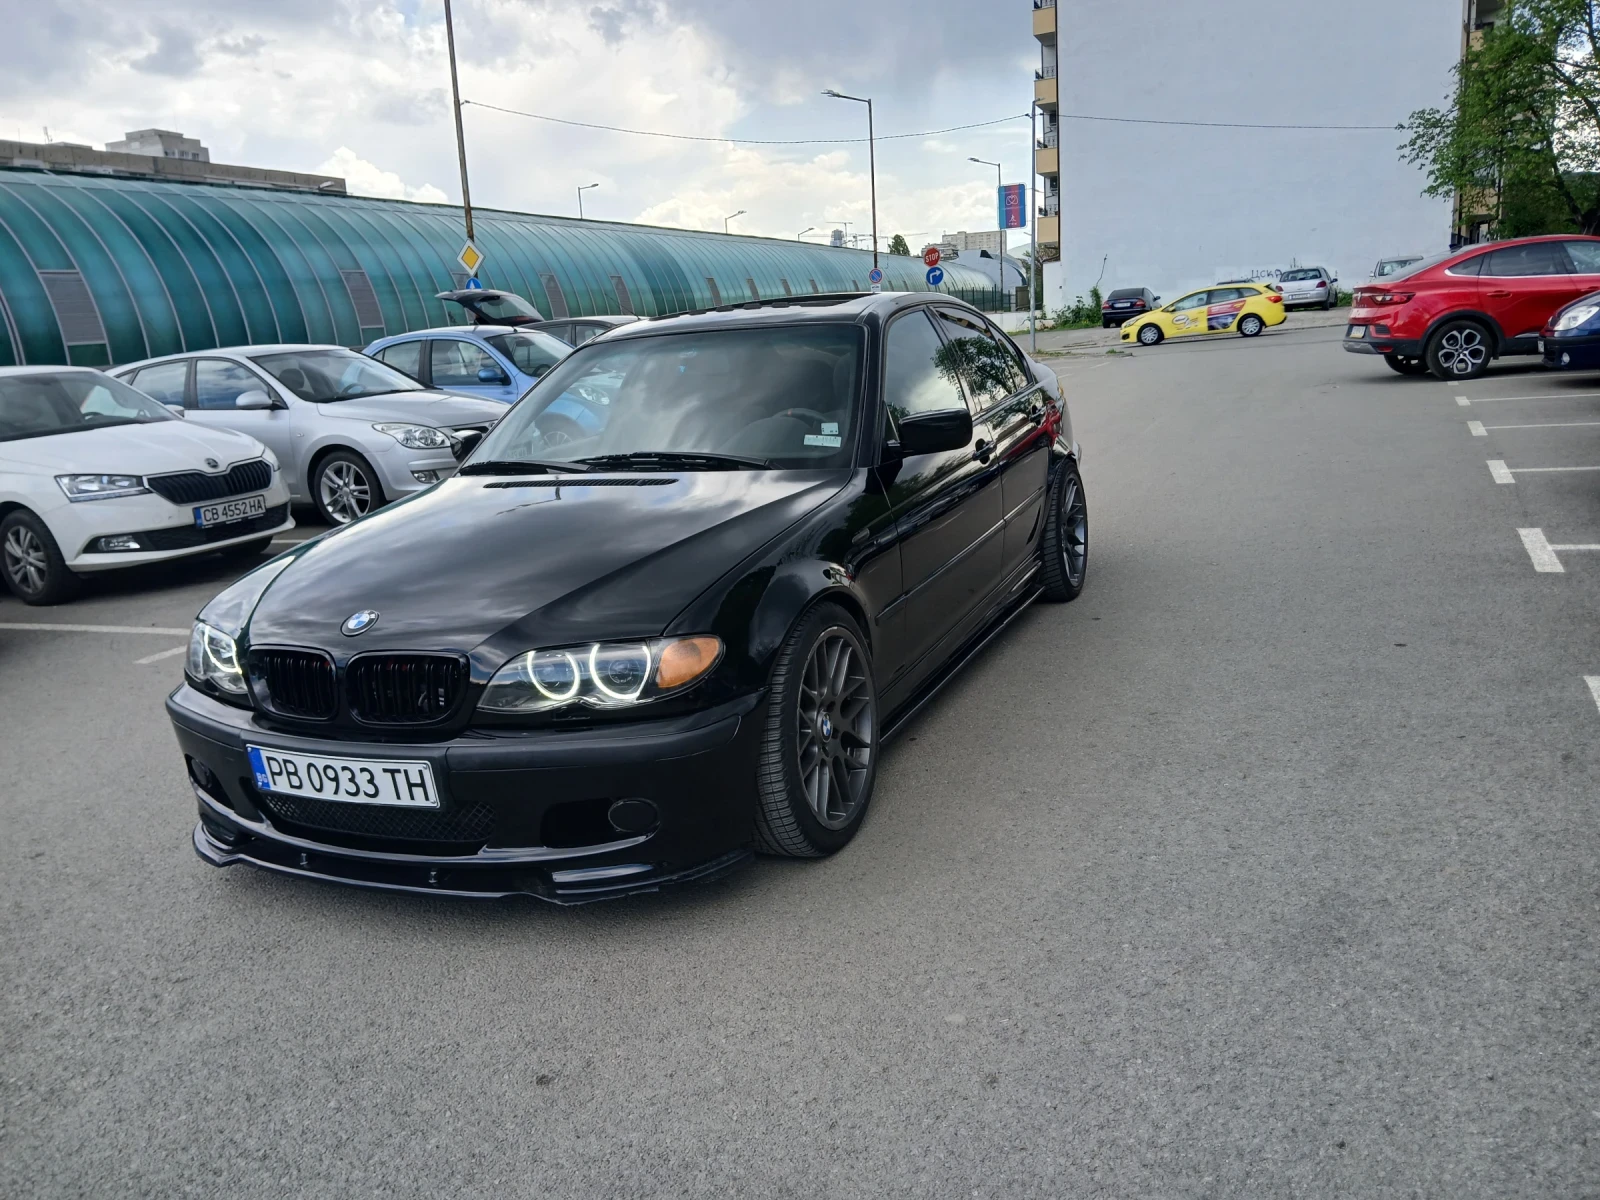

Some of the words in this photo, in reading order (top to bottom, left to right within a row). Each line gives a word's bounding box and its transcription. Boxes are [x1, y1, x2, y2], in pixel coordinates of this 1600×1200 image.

[925, 252, 939, 263] STOP
[203, 507, 220, 522] CB
[222, 502, 248, 519] 4552
[248, 499, 263, 513] HA
[256, 772, 268, 784] BG
[265, 756, 303, 789] PB
[306, 762, 379, 798] 0933
[382, 768, 430, 801] TH
